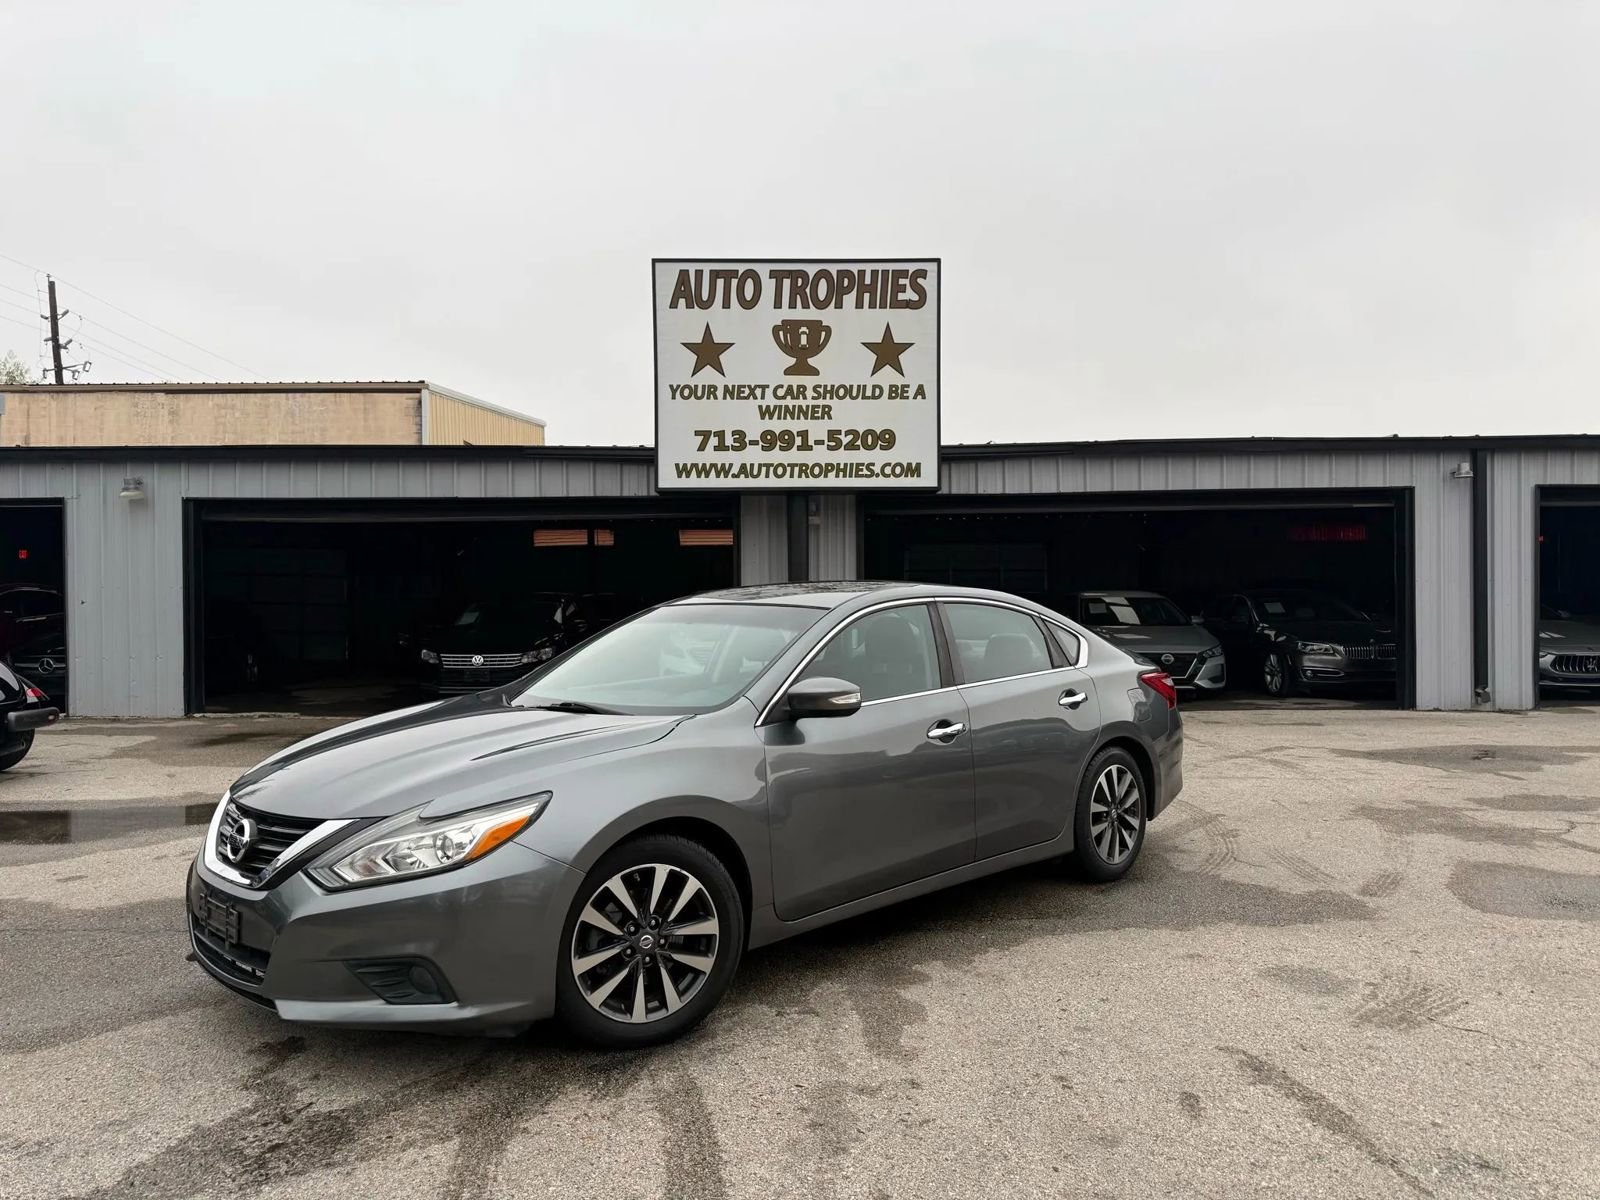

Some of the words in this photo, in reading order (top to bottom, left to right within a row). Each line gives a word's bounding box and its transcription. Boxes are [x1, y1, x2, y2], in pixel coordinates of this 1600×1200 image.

[669, 268, 763, 311] AUTO
[768, 268, 929, 311] TROPHIES
[668, 383, 719, 401] YOUR
[722, 383, 770, 401] NEXT
[772, 383, 808, 401] CAR
[811, 383, 885, 401] SHOULD
[887, 383, 911, 401] BE
[912, 383, 927, 401] A
[757, 404, 833, 421] WINNER
[693, 428, 897, 453] 713-991-5209
[674, 461, 922, 480] WWW.AUTOTROPHIES.COM
